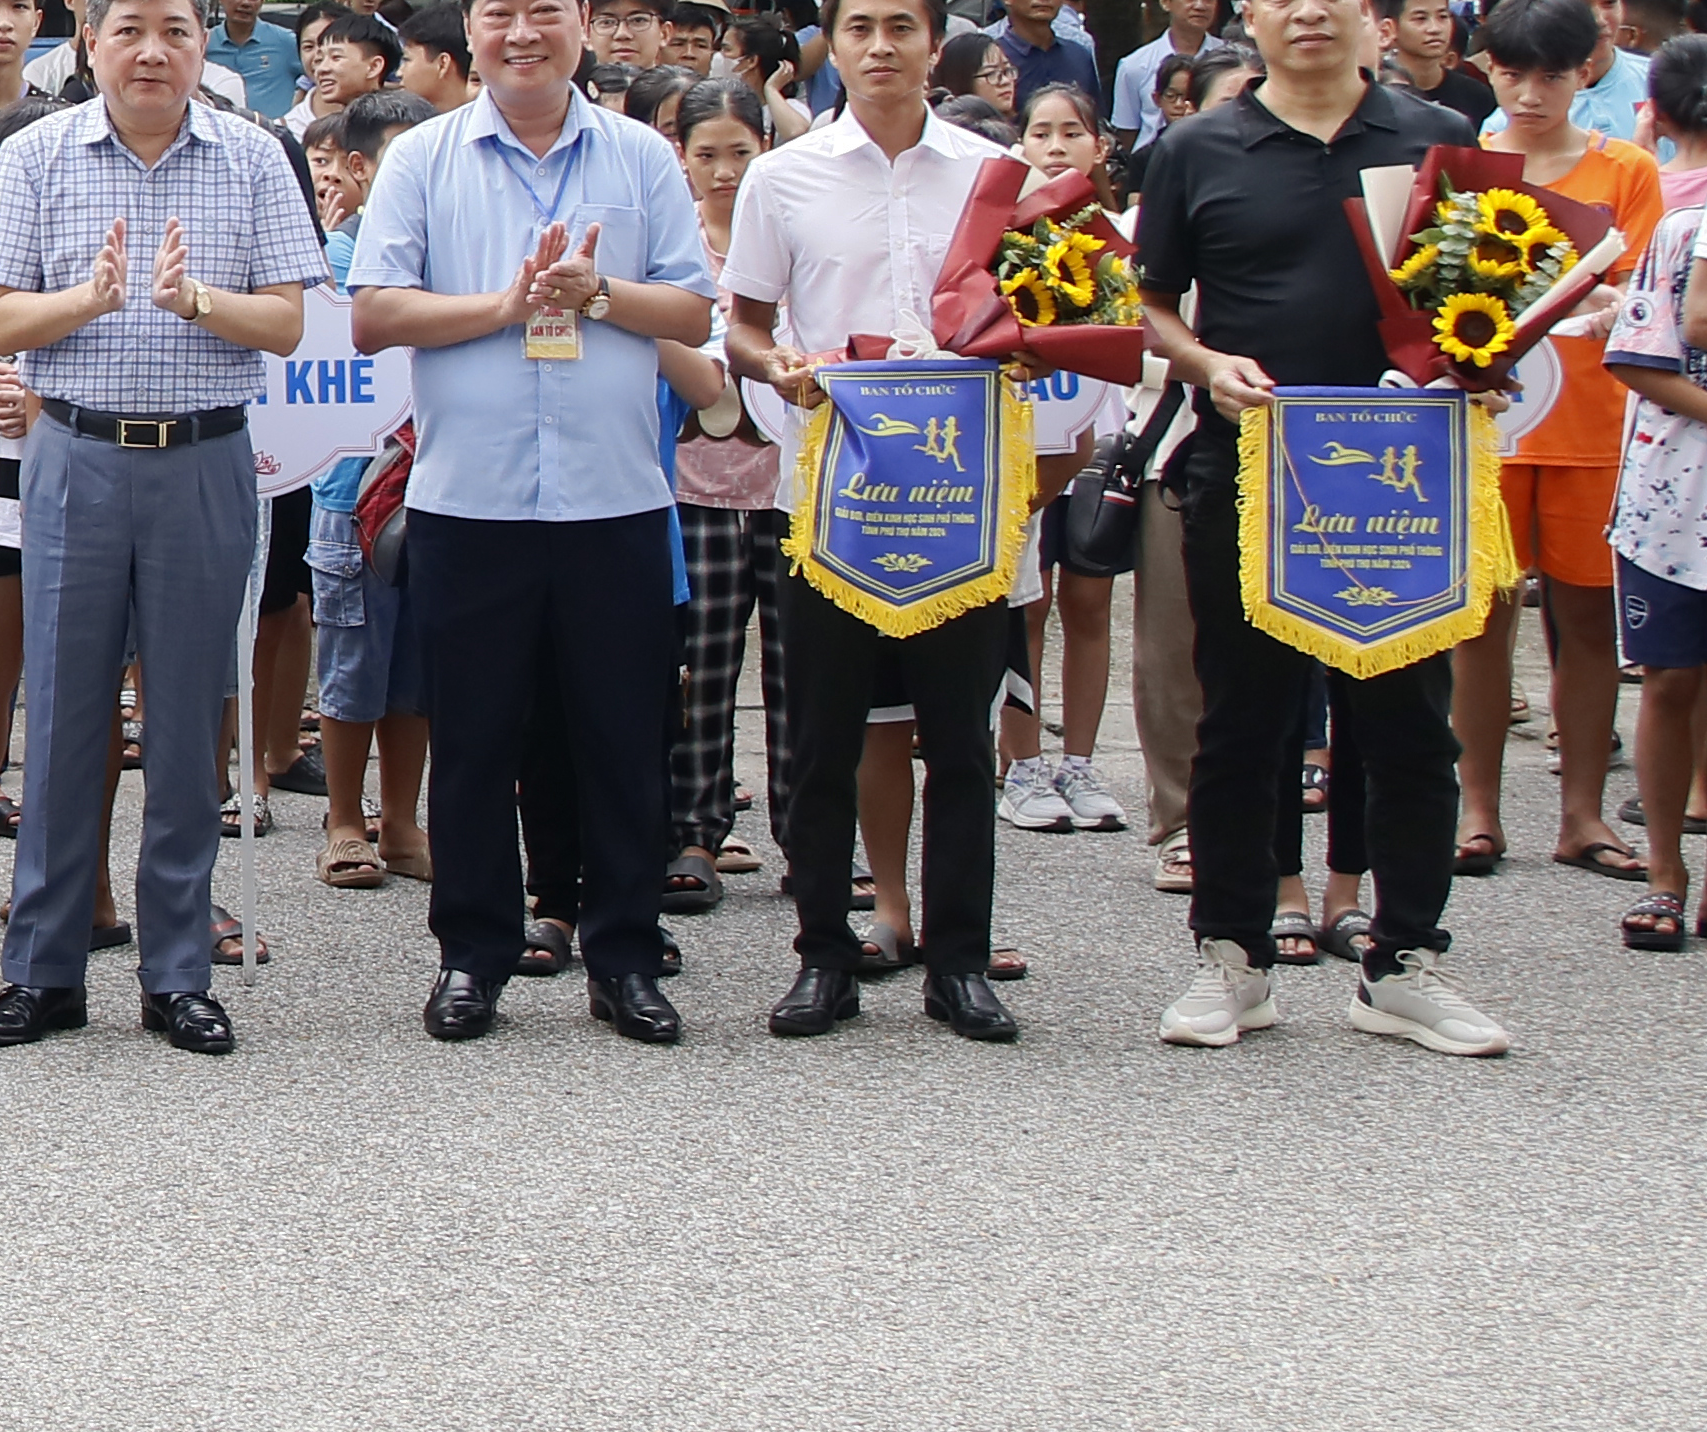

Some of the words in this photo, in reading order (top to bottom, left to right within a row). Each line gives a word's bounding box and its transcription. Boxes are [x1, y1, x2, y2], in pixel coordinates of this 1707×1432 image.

[860, 386, 889, 396] BAN
[891, 382, 912, 395] TỔ
[915, 384, 956, 395] CHỨC
[1315, 412, 1346, 422] BAN
[1349, 409, 1371, 422] TỔ
[1373, 410, 1418, 423] CHỨC
[837, 472, 900, 503] Lưu
[908, 478, 974, 508] niệm
[1292, 504, 1356, 533] Lưu
[1366, 509, 1440, 540] niệm
